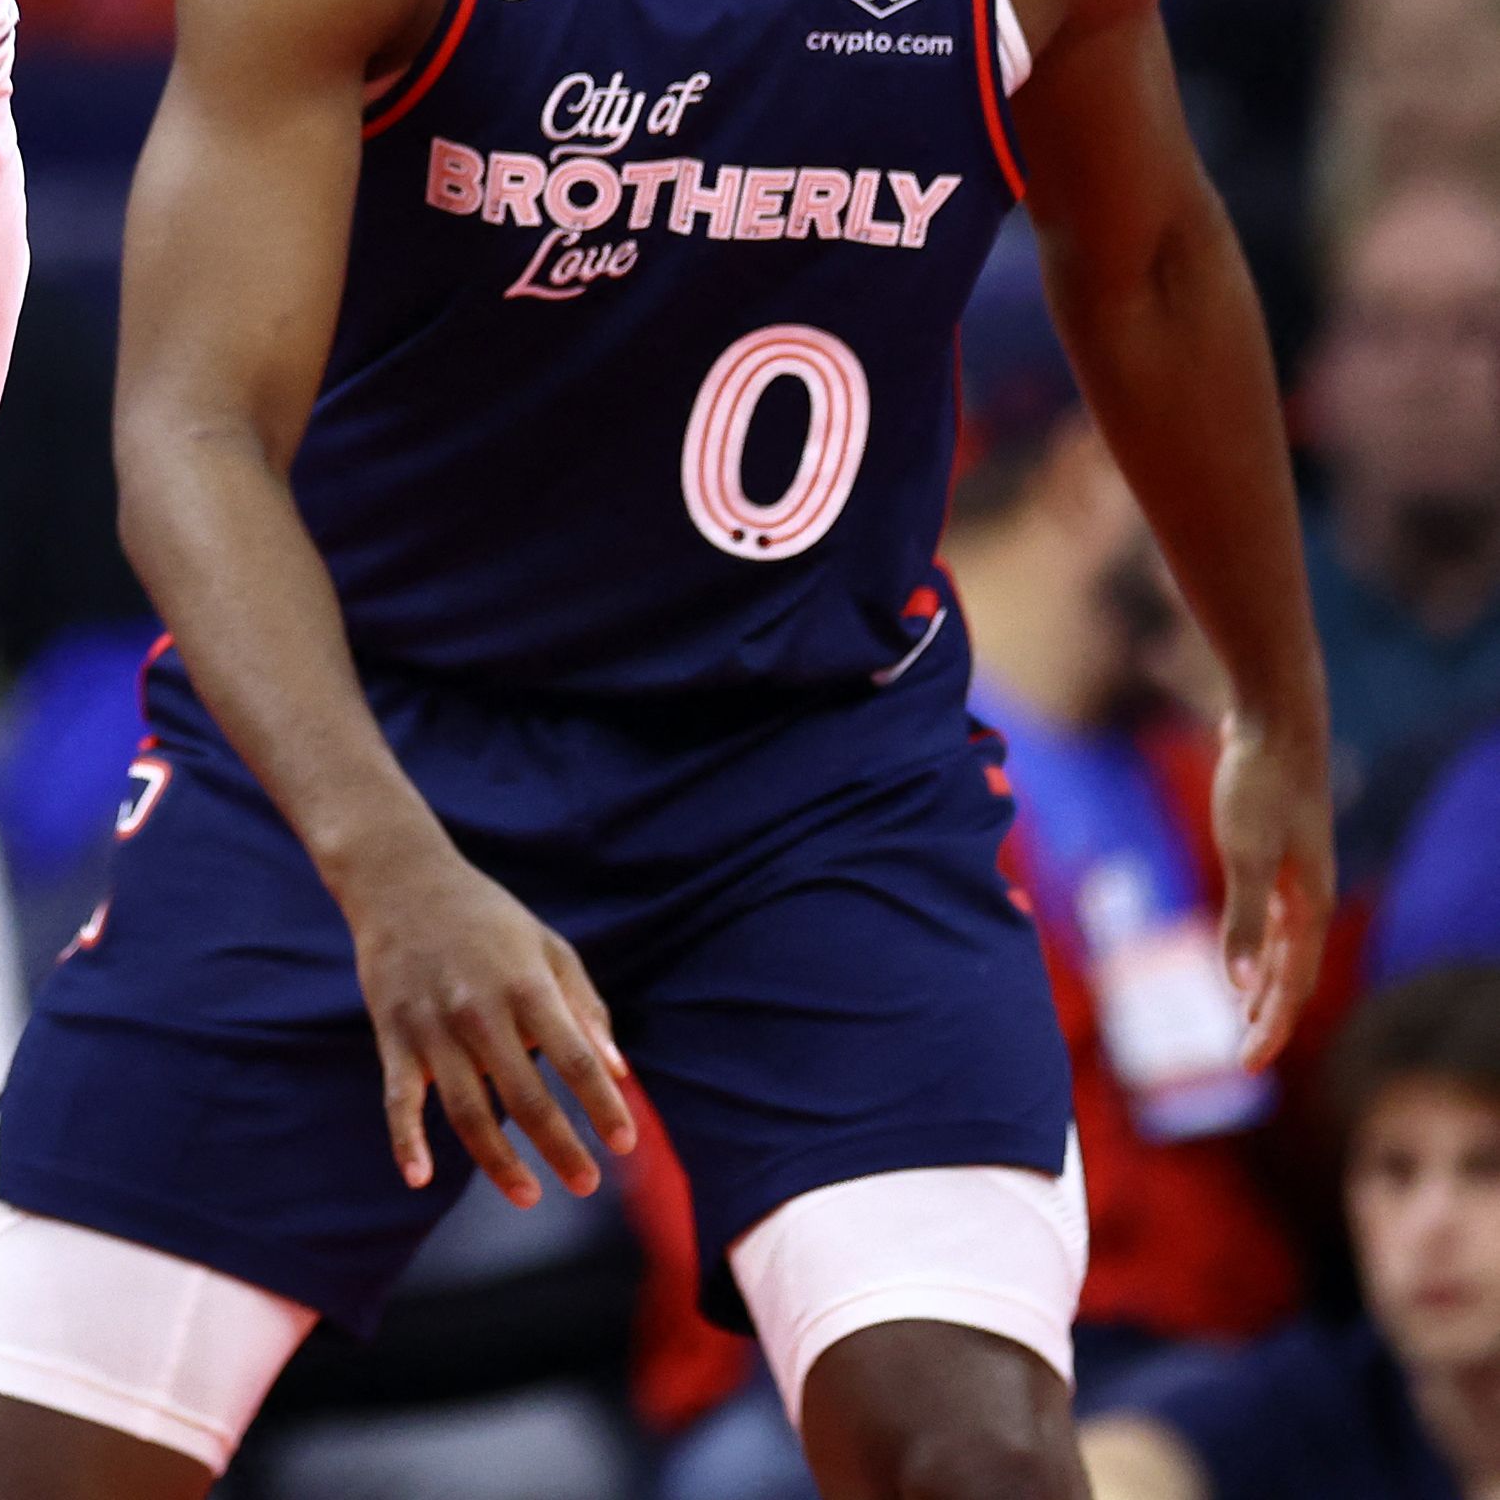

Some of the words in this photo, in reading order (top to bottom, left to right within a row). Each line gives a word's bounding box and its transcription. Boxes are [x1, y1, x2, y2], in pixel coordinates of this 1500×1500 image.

[806, 29, 953, 56] crypto.com
[541, 72, 644, 164] City
[647, 71, 711, 137] of
[426, 137, 962, 249] BROTHERLY
[504, 227, 640, 300] Love
[680, 323, 871, 562] 0
